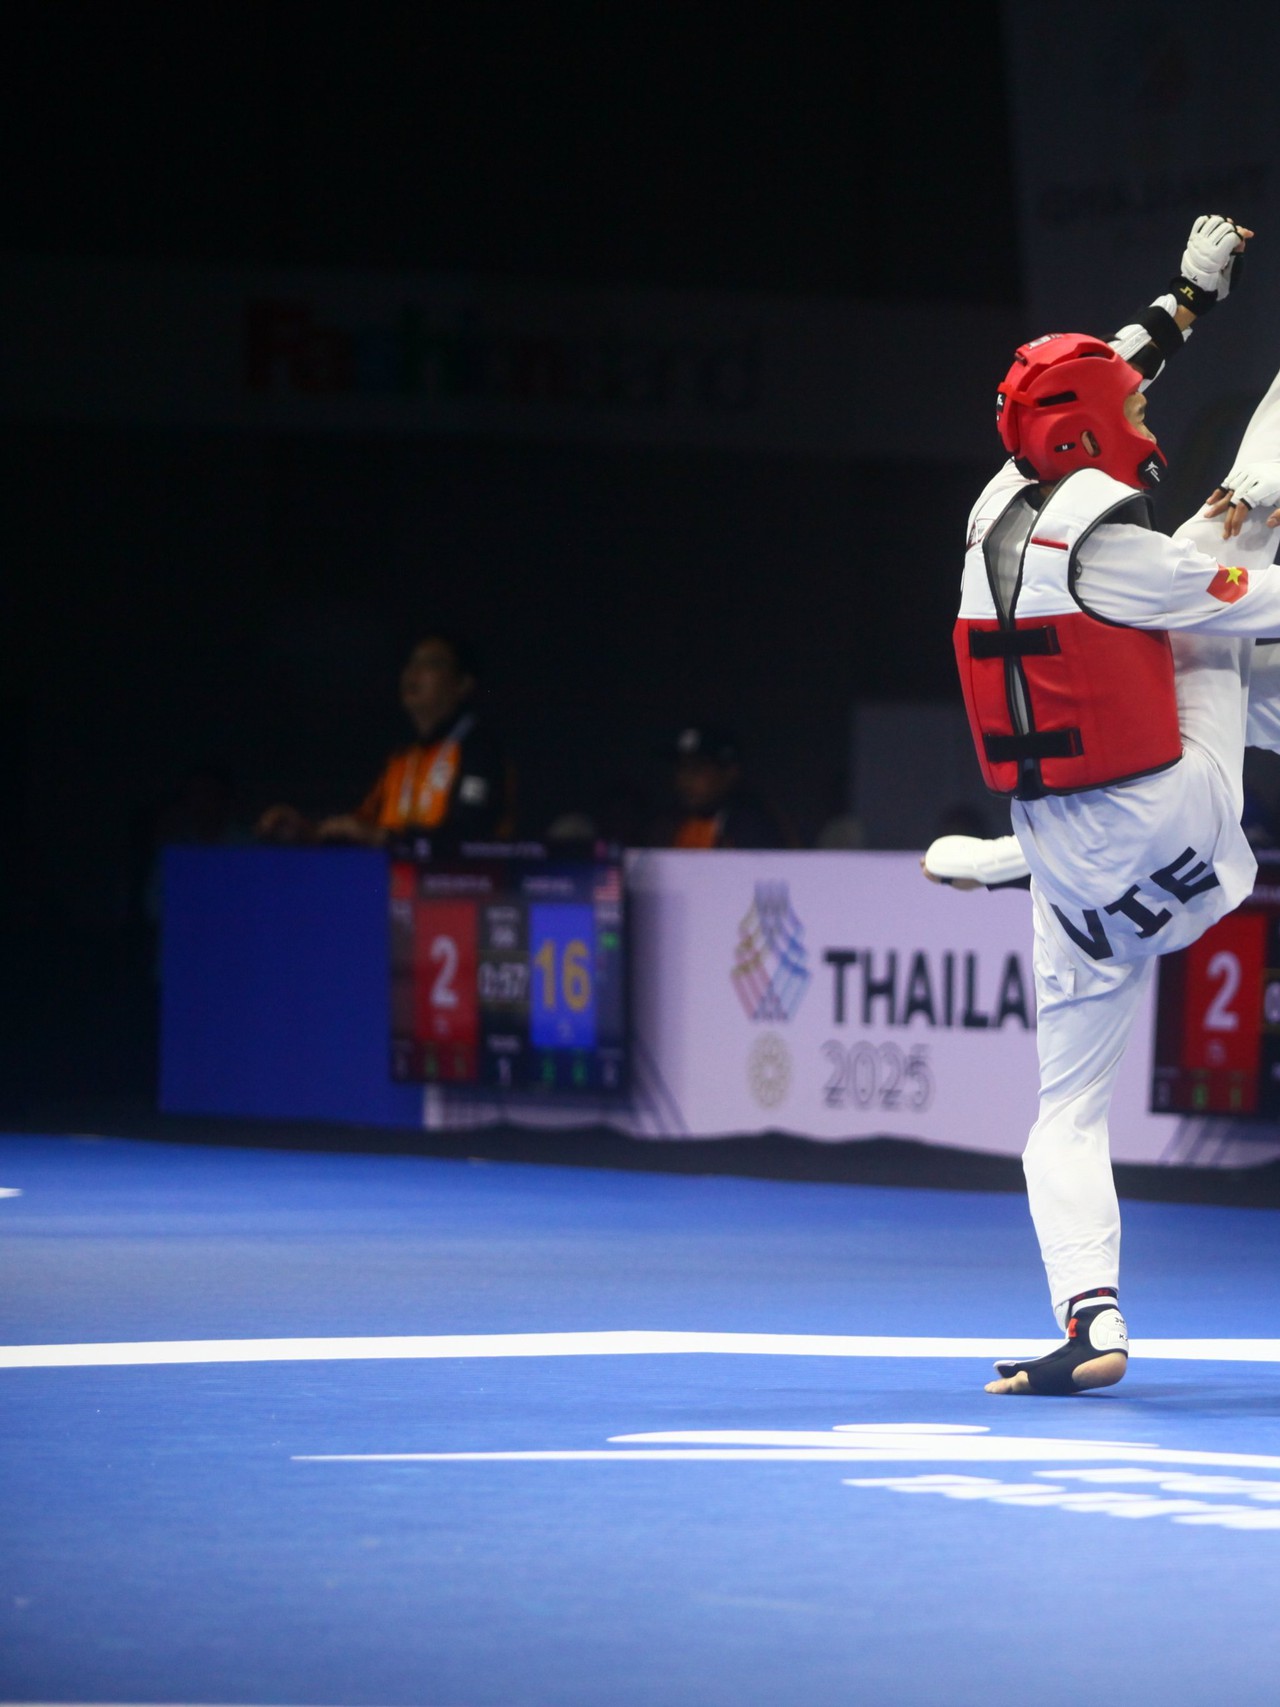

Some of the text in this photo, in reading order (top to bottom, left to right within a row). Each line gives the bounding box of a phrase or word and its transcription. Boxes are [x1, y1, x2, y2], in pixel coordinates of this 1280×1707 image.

[1050, 846, 1221, 961] VIE
[429, 933, 459, 1009] 2
[533, 938, 591, 1013] 16
[822, 946, 1037, 1031] THAILA
[1203, 950, 1242, 1032] 2
[820, 1038, 935, 1113] 2025
